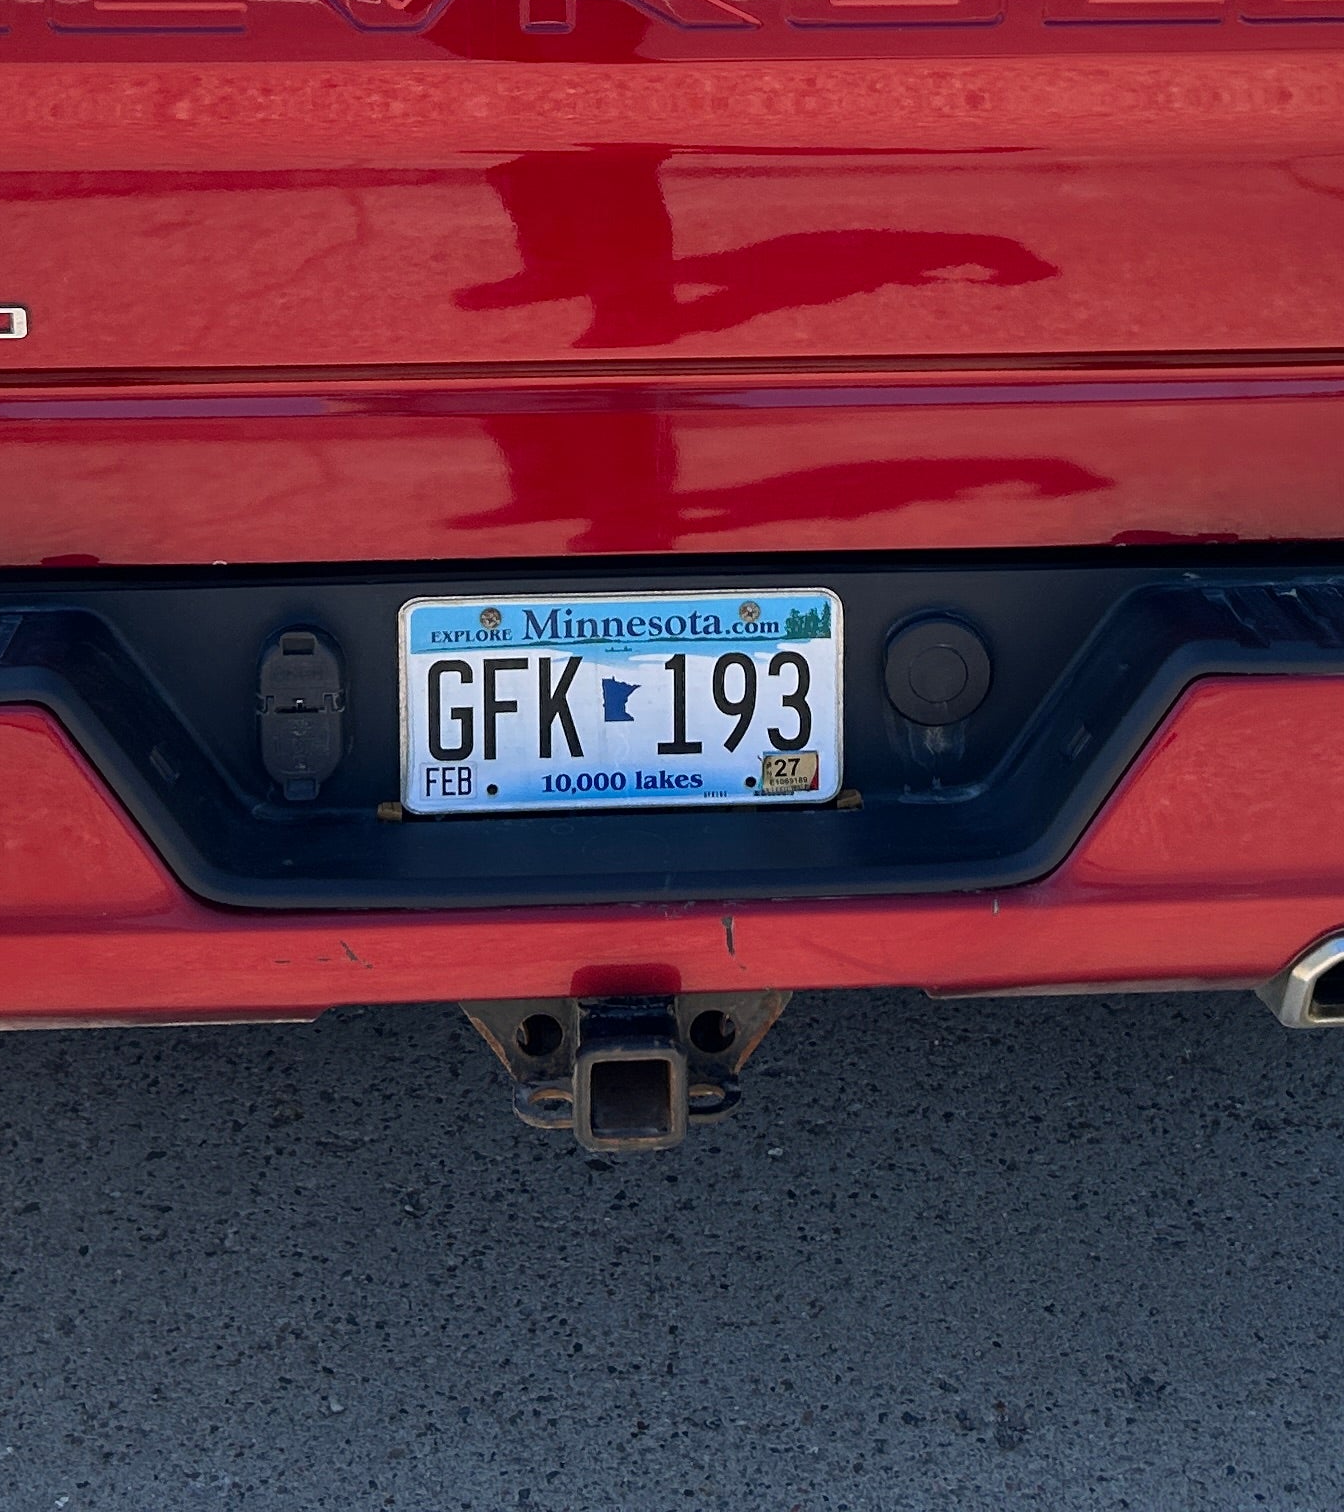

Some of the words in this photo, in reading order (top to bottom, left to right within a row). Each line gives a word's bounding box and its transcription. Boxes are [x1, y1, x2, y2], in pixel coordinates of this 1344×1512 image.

[430, 628, 513, 644] EXPLORE
[522, 607, 780, 640] Minnesota.com
[427, 655, 585, 761] GFK
[657, 651, 813, 756] 193
[425, 766, 473, 797] FEB
[541, 771, 628, 795] 10,000
[635, 769, 704, 790] lakes
[774, 758, 801, 778] 27
